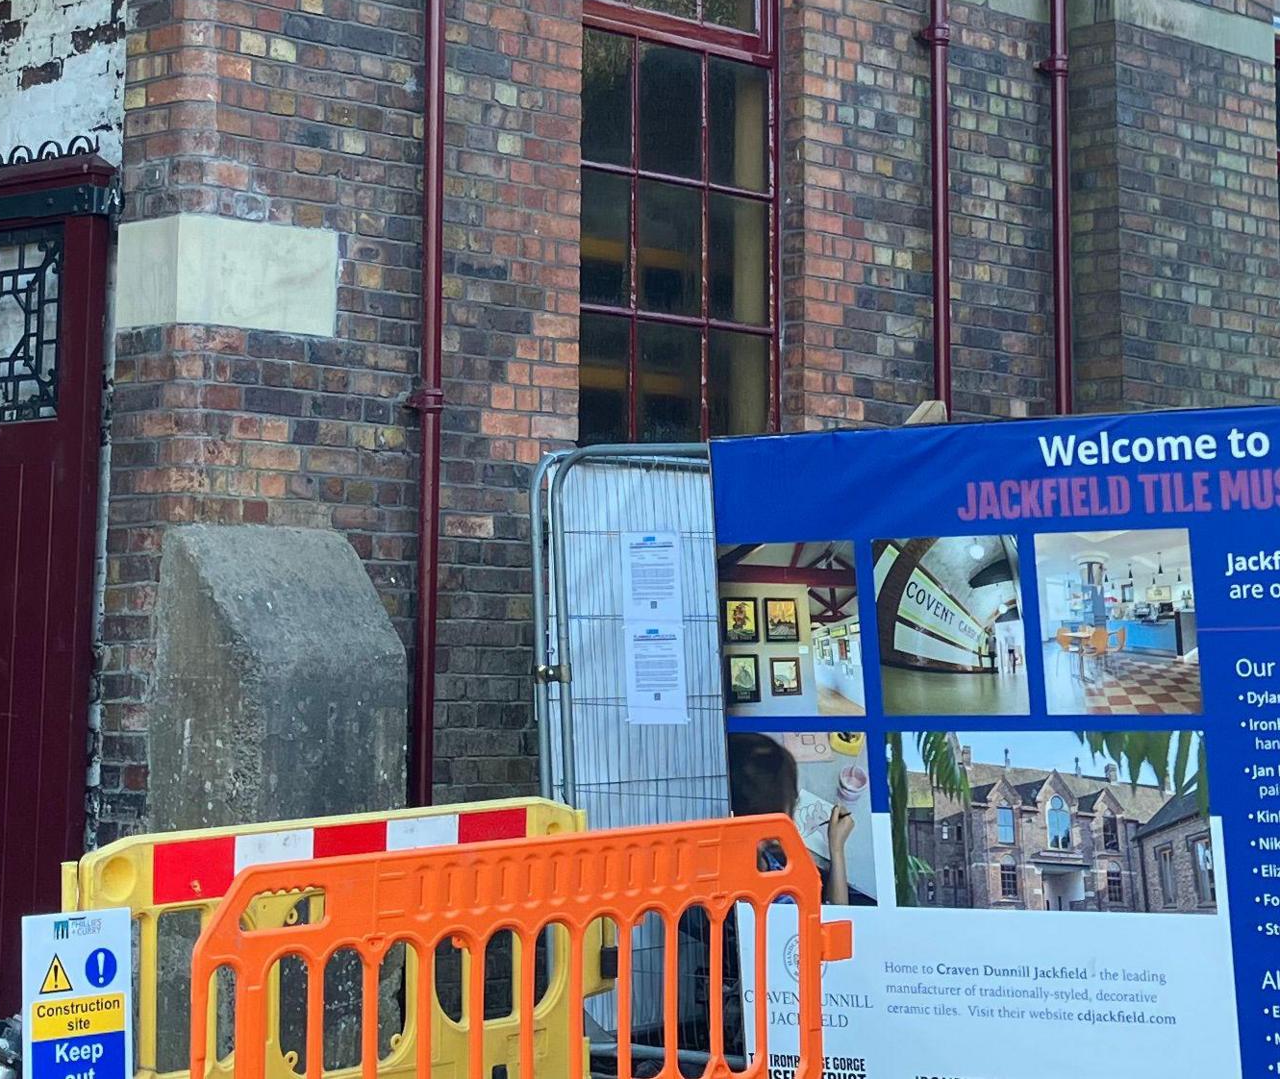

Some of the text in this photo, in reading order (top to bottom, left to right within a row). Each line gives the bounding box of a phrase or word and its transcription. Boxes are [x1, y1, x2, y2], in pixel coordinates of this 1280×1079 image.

[1038, 429, 1269, 466] Welcome to
[957, 475, 1130, 521] JACKFIELD
[1138, 471, 1212, 514] TILE
[1230, 584, 1263, 598] are
[906, 581, 955, 624] COVENT
[1236, 659, 1275, 677] Our
[1252, 765, 1274, 779] Jan
[885, 962, 1167, 985] Home to Craven Dunnill Jackfield the leading
[886, 983, 1157, 1003] manufacturer of traditionally-styled, decorative
[37, 998, 120, 1018] Construction
[887, 1004, 1176, 1024] ceramic tiles. Visit their website cdjackfield.com
[67, 1018, 90, 1031] site
[55, 1042, 104, 1063] Keep
[832, 1057, 866, 1071] GORGE
